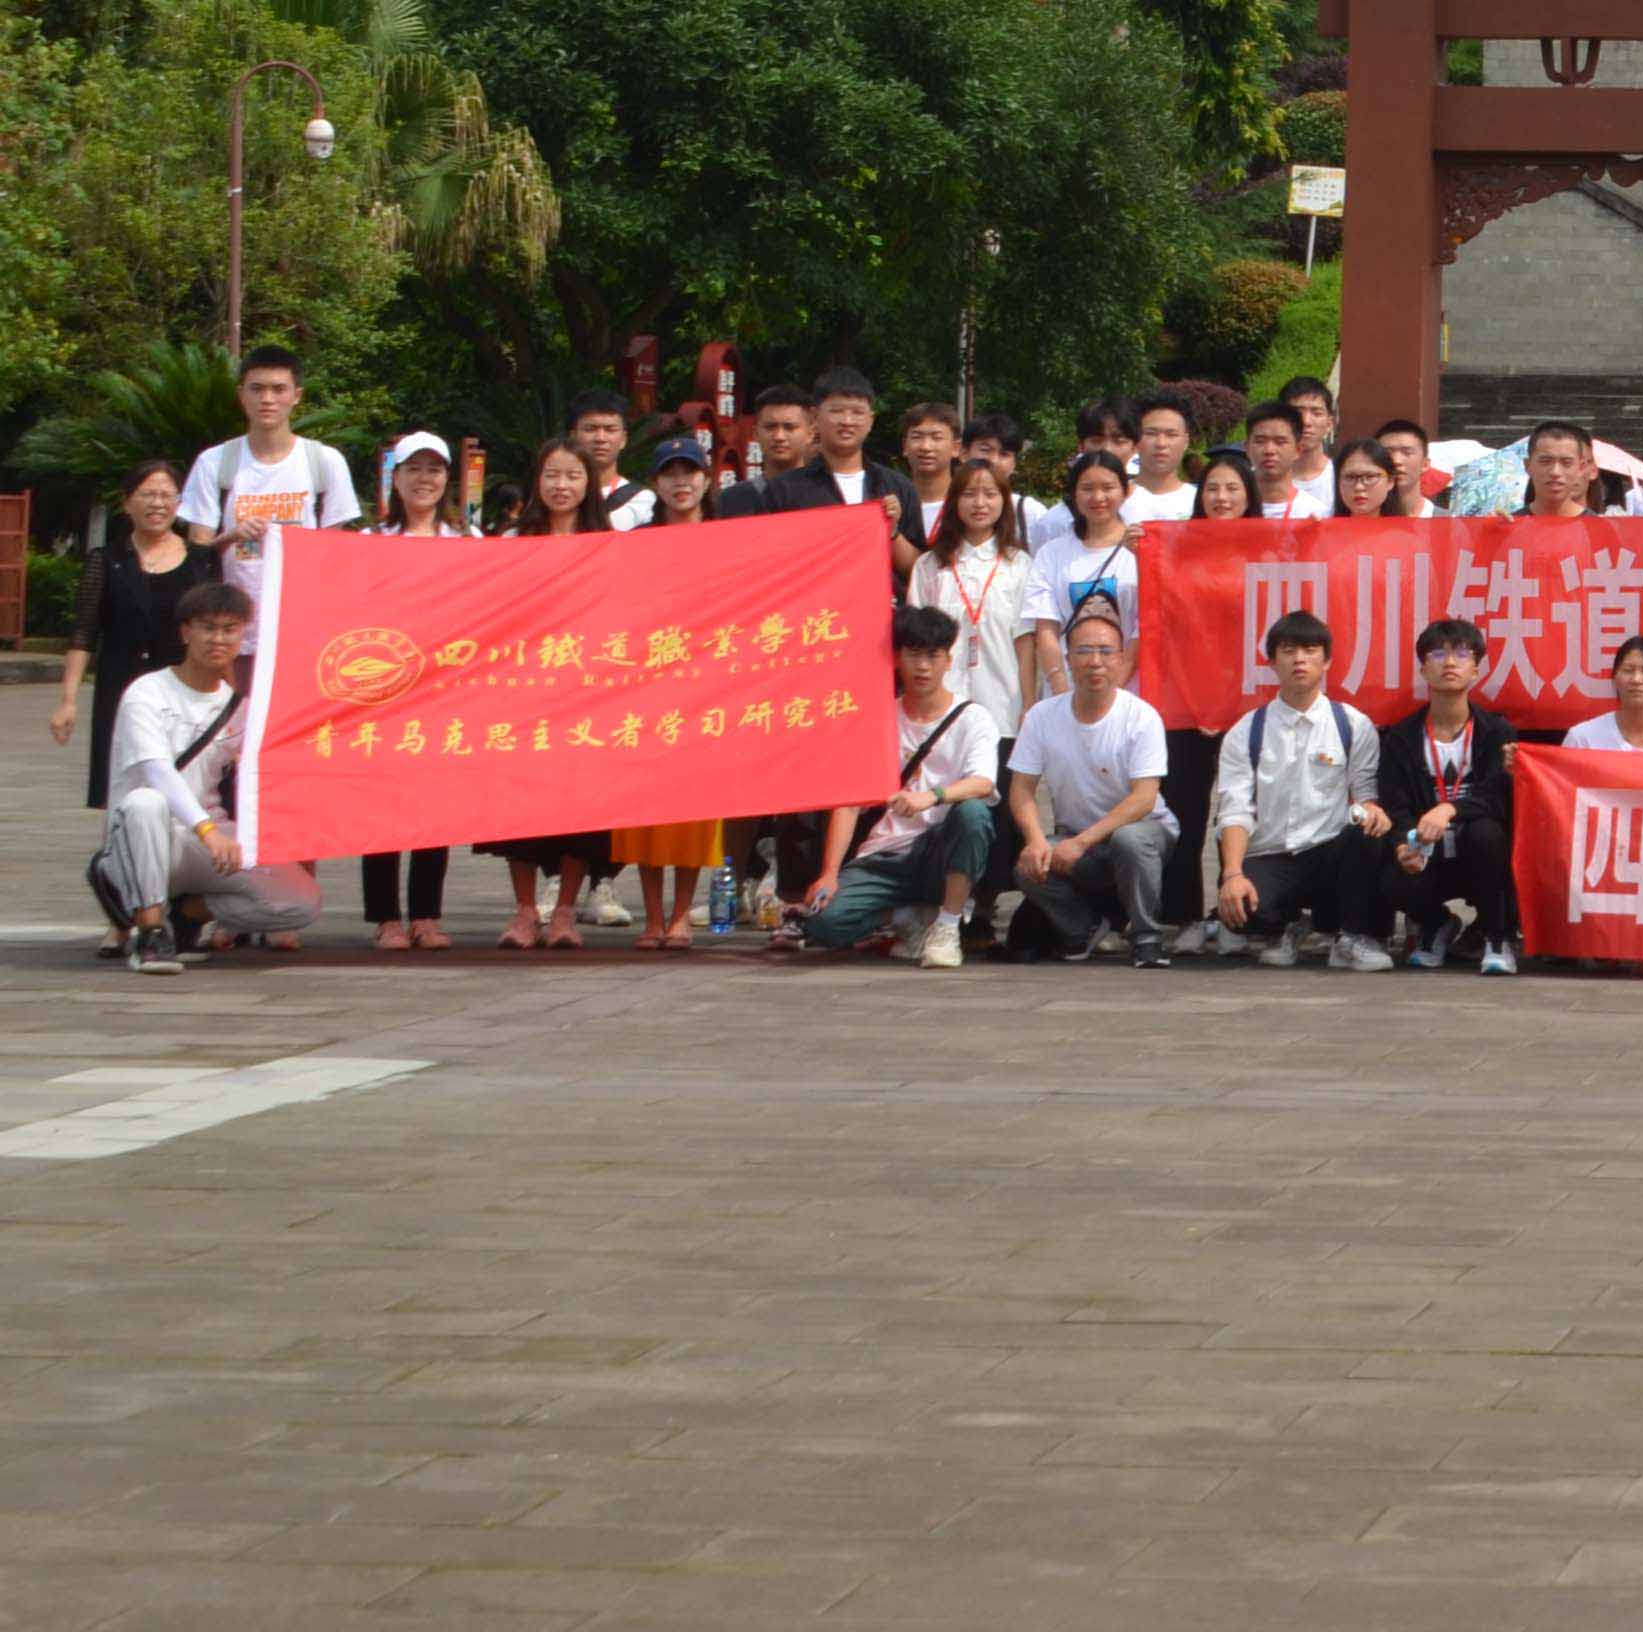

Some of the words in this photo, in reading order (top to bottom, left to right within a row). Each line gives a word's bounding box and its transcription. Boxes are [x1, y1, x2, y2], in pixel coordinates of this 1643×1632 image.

[306, 689, 860, 758] 青年马克思主义者学习研究社
